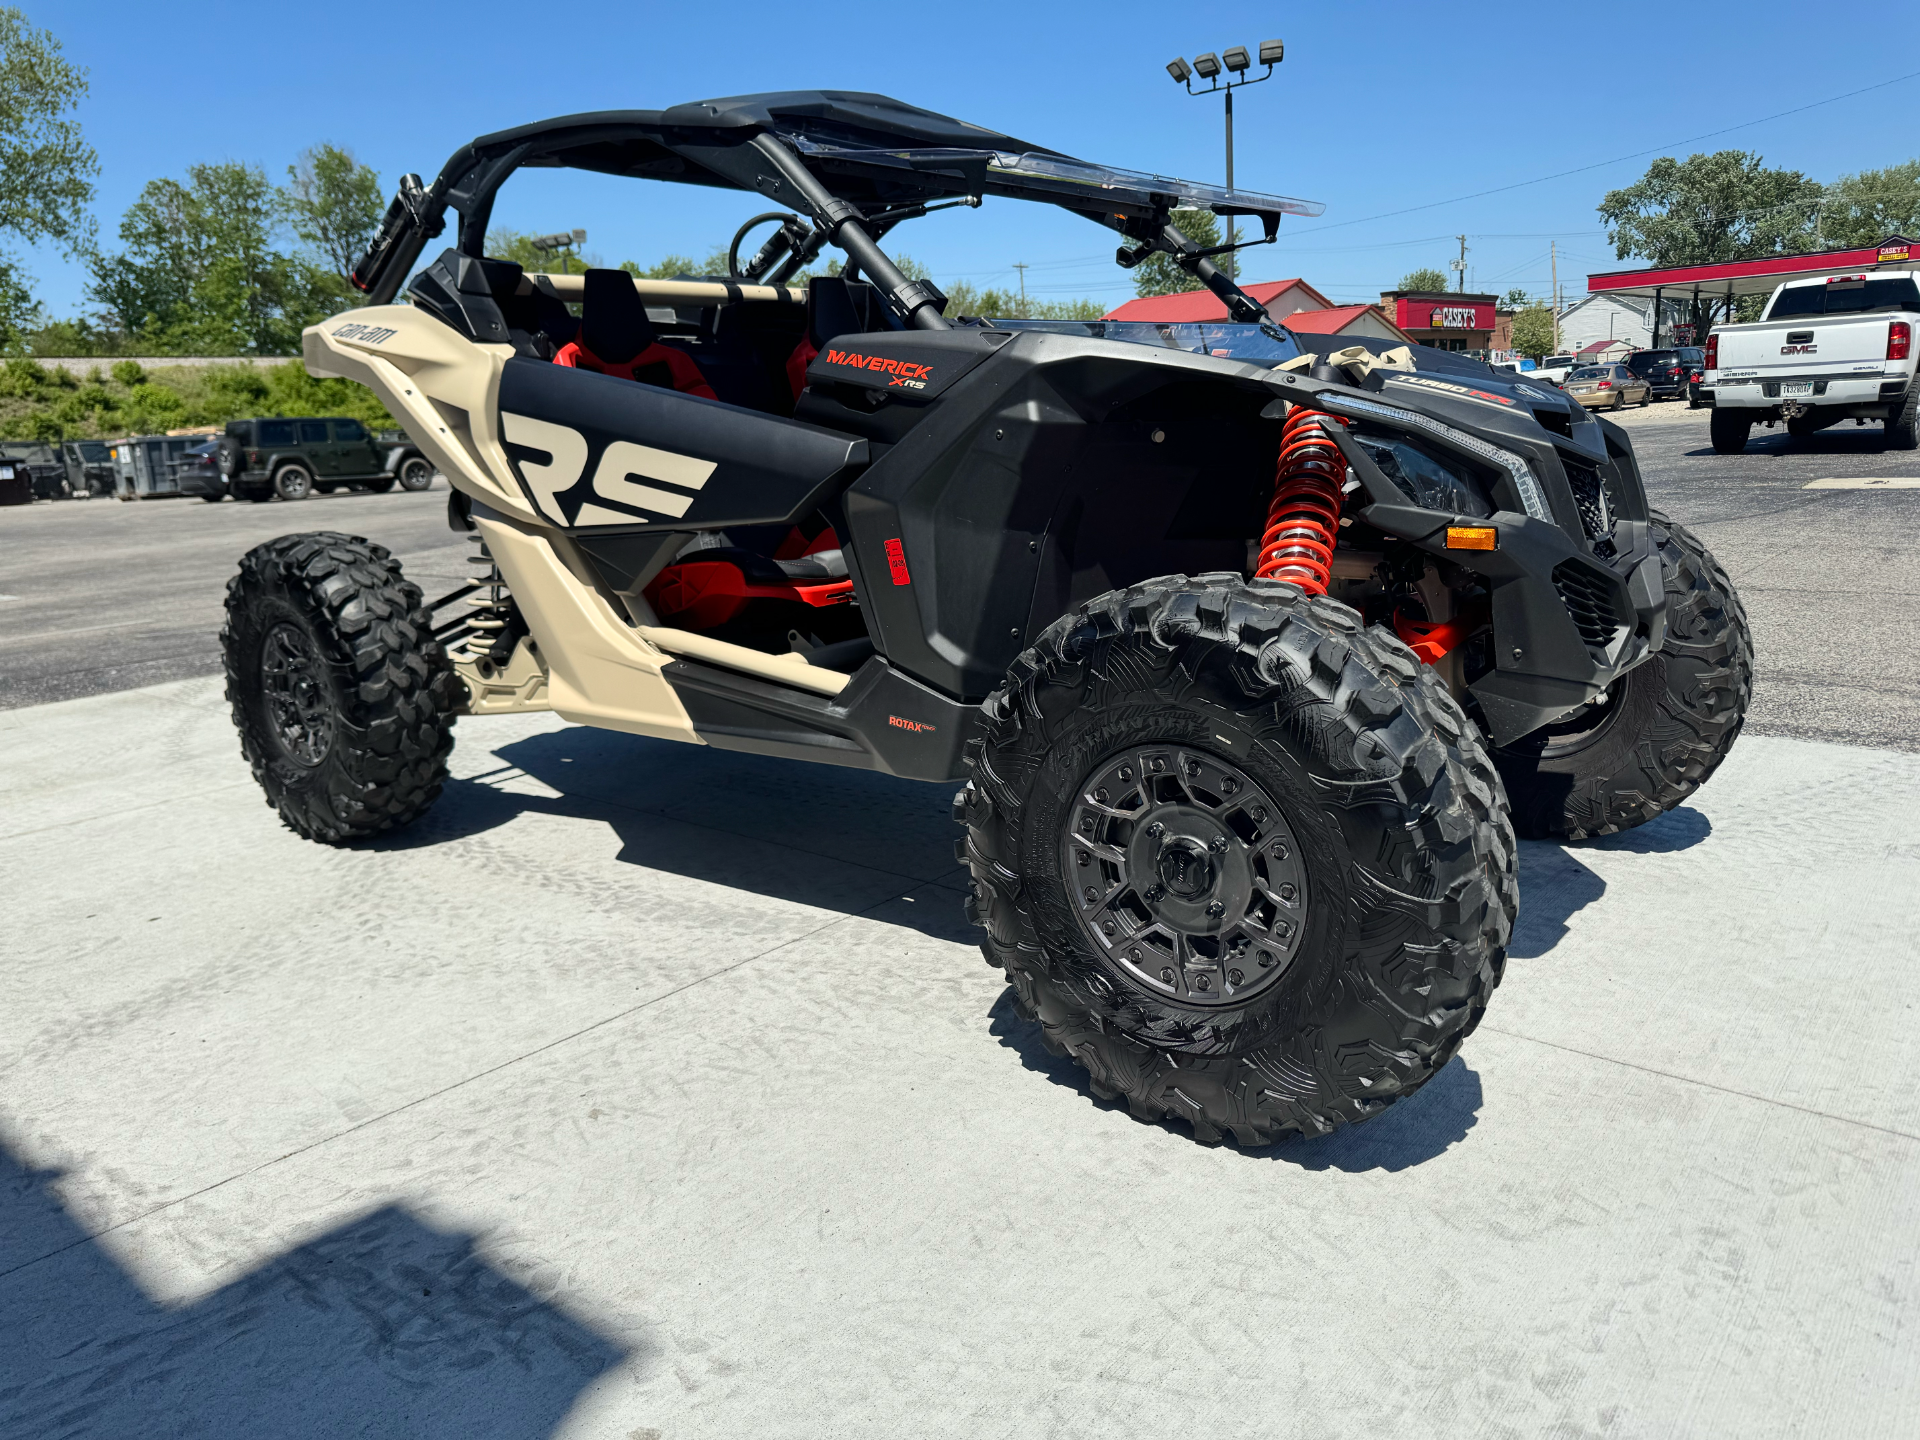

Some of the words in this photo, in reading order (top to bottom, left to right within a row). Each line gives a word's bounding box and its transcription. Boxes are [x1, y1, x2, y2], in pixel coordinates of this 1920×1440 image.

[1880, 246, 1908, 254] CASEY'S
[1442, 307, 1476, 328] CASEY'S
[1780, 344, 1817, 356] GMC
[826, 349, 934, 380] MAVERICK
[1397, 375, 1469, 393] TURBO
[1469, 390, 1511, 405] RR
[501, 411, 718, 527] RS
[889, 716, 922, 733] ROTAX
